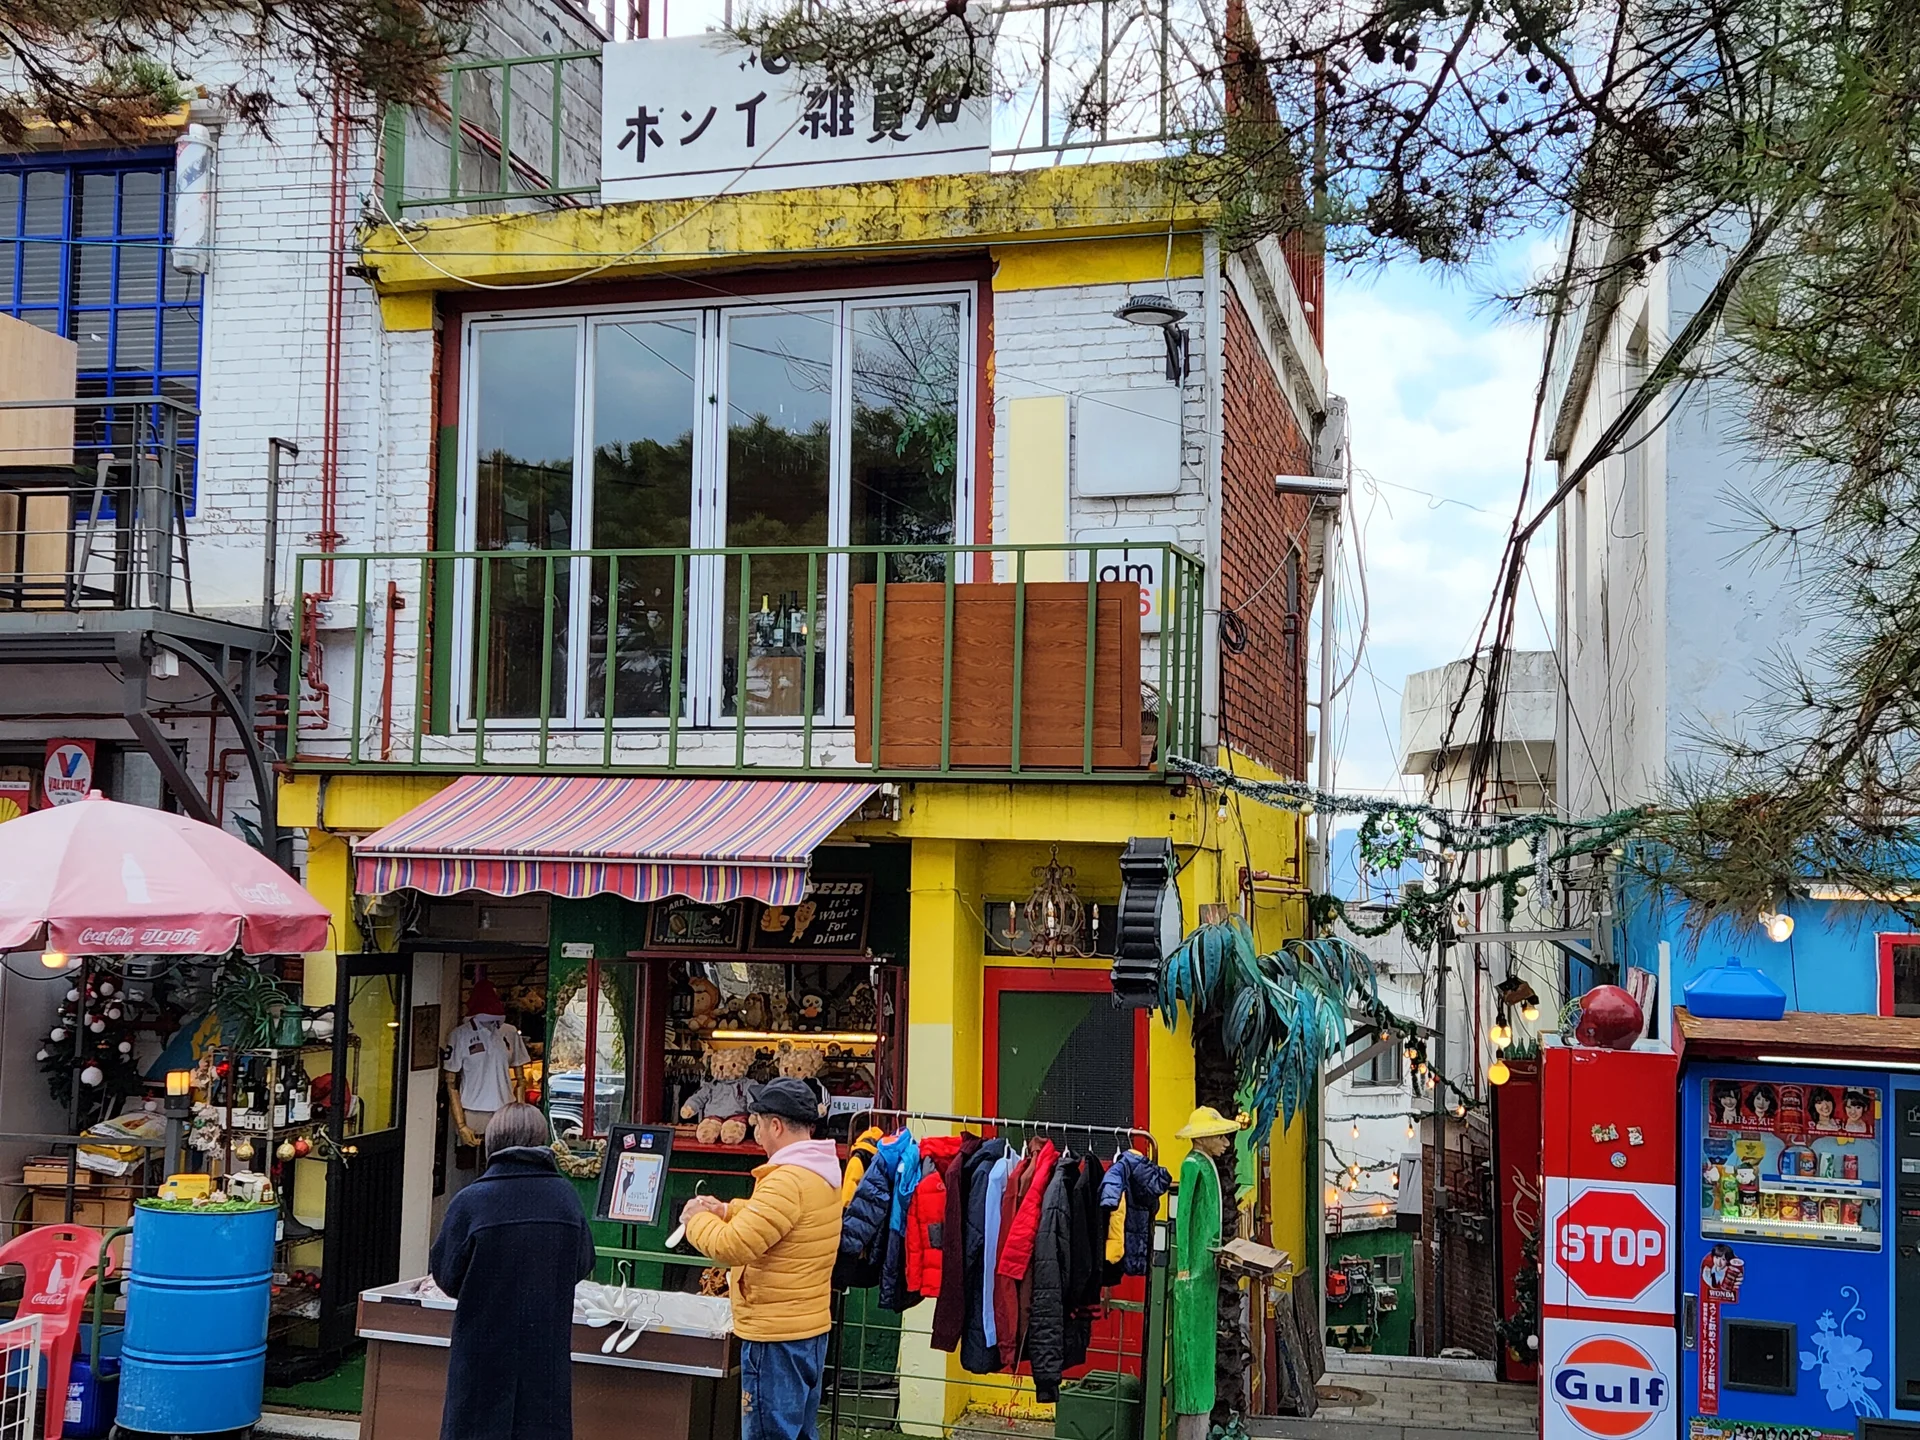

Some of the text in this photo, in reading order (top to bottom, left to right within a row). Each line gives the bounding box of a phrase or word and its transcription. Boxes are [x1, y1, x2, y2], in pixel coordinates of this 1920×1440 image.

[1099, 564, 1154, 585] am
[668, 898, 685, 911] ARE
[828, 898, 850, 909] It's
[819, 908, 859, 921] What's
[826, 922, 847, 932] For
[694, 937, 724, 945] FOOTBALL
[813, 932, 857, 945] Dinner
[833, 1101, 859, 1111] 데일리
[1561, 1224, 1662, 1267] STOP
[1709, 1289, 1736, 1300] WONDA
[1554, 1369, 1665, 1406] Gulf
